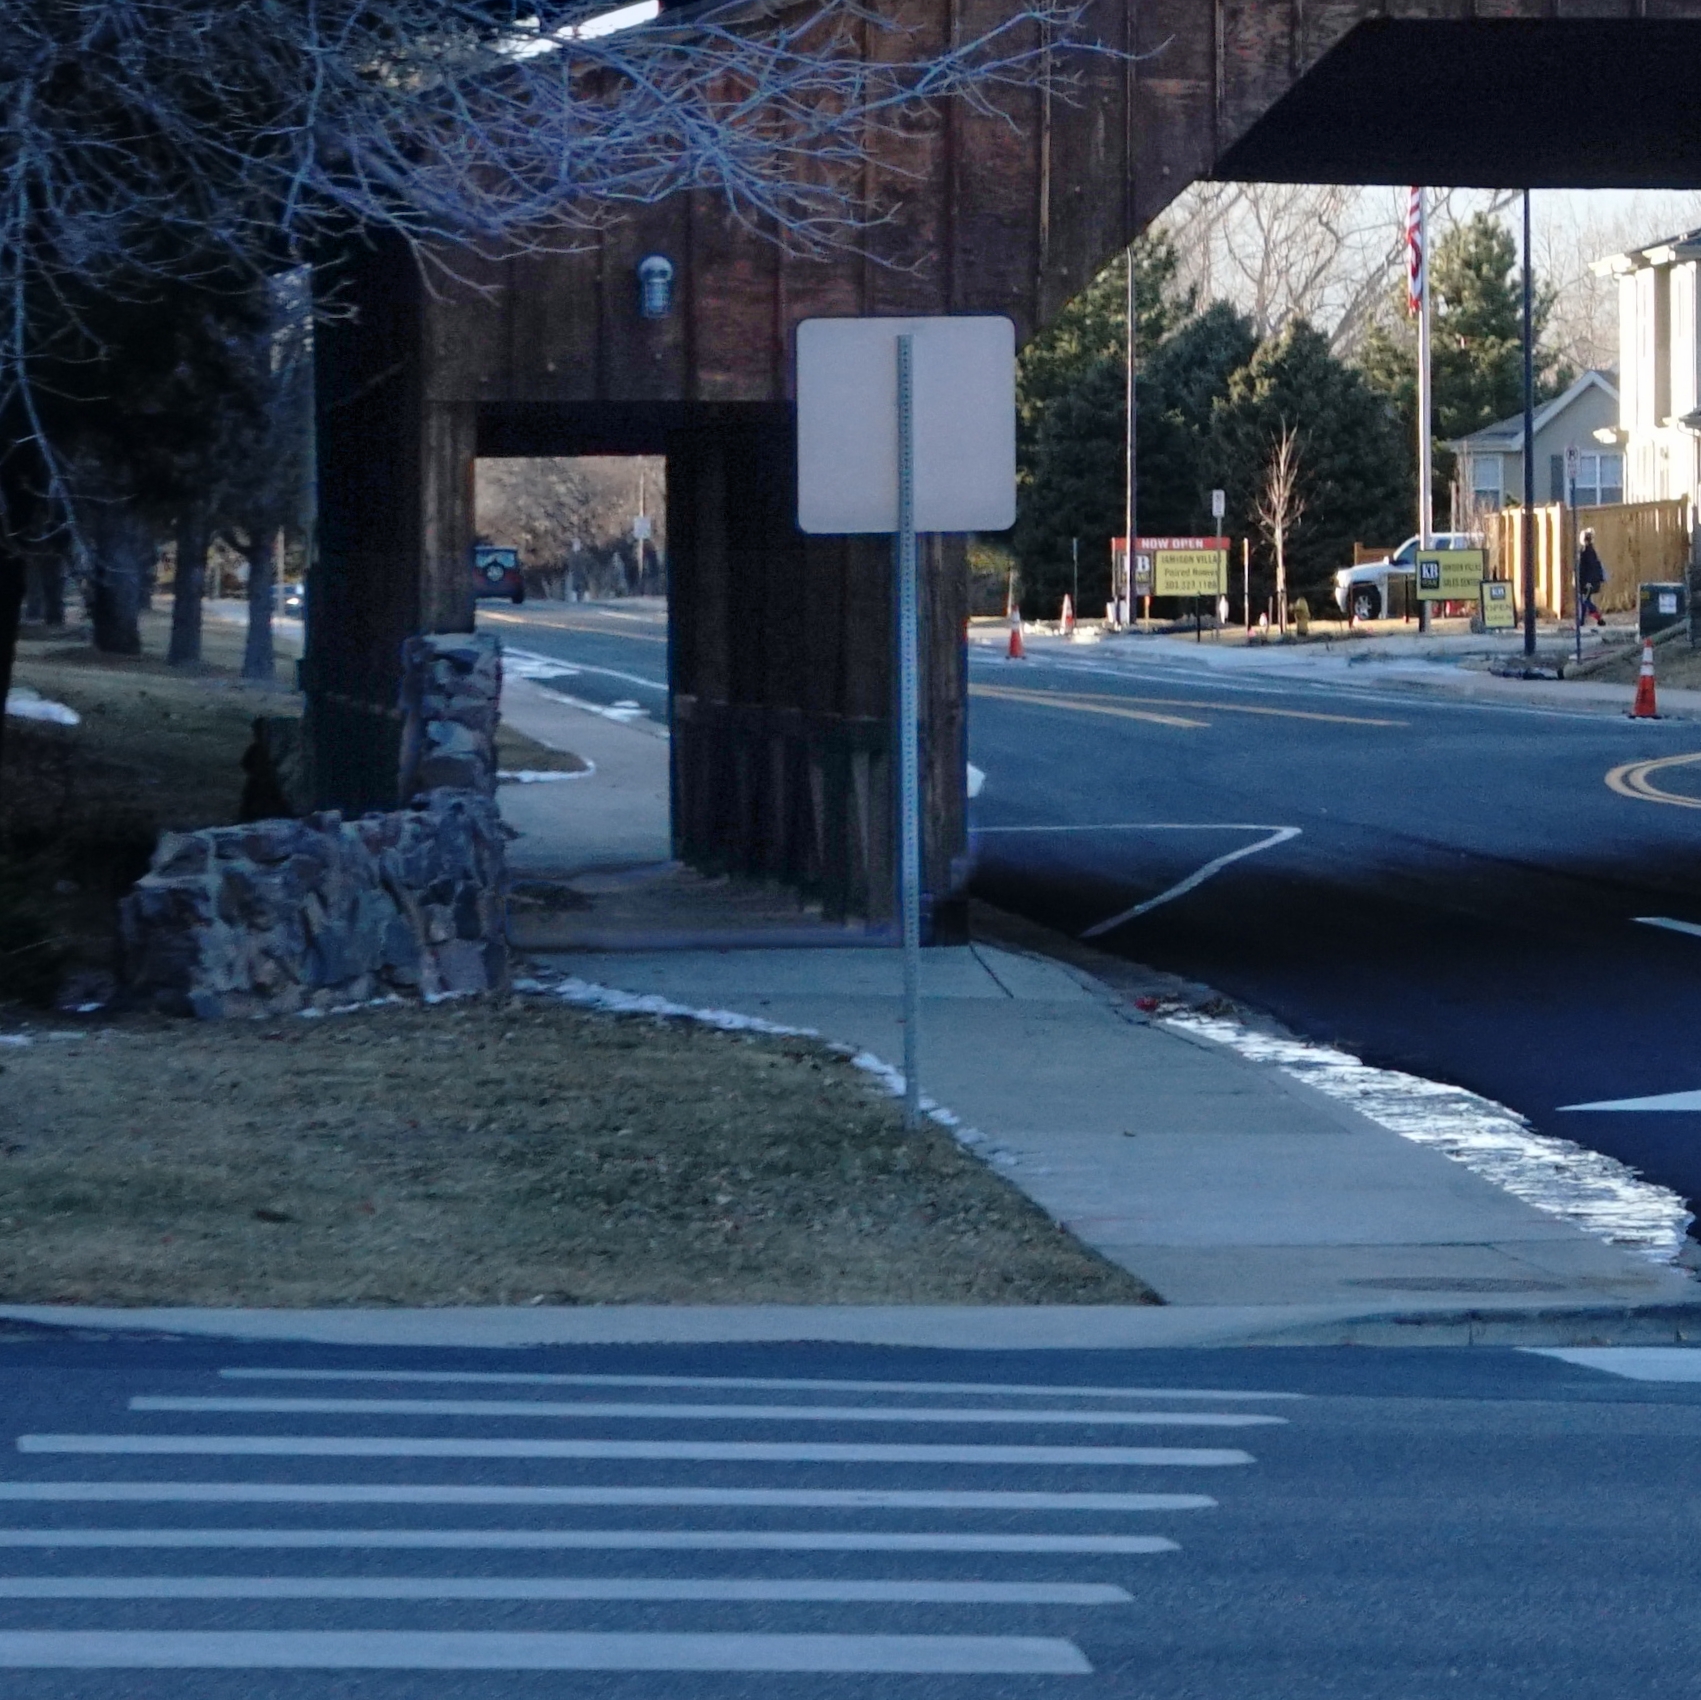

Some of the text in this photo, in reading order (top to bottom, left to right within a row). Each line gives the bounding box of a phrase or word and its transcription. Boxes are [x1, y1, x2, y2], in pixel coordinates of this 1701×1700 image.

[1141, 538, 1203, 549] NOW OPEN
[1422, 563, 1438, 579] KB
